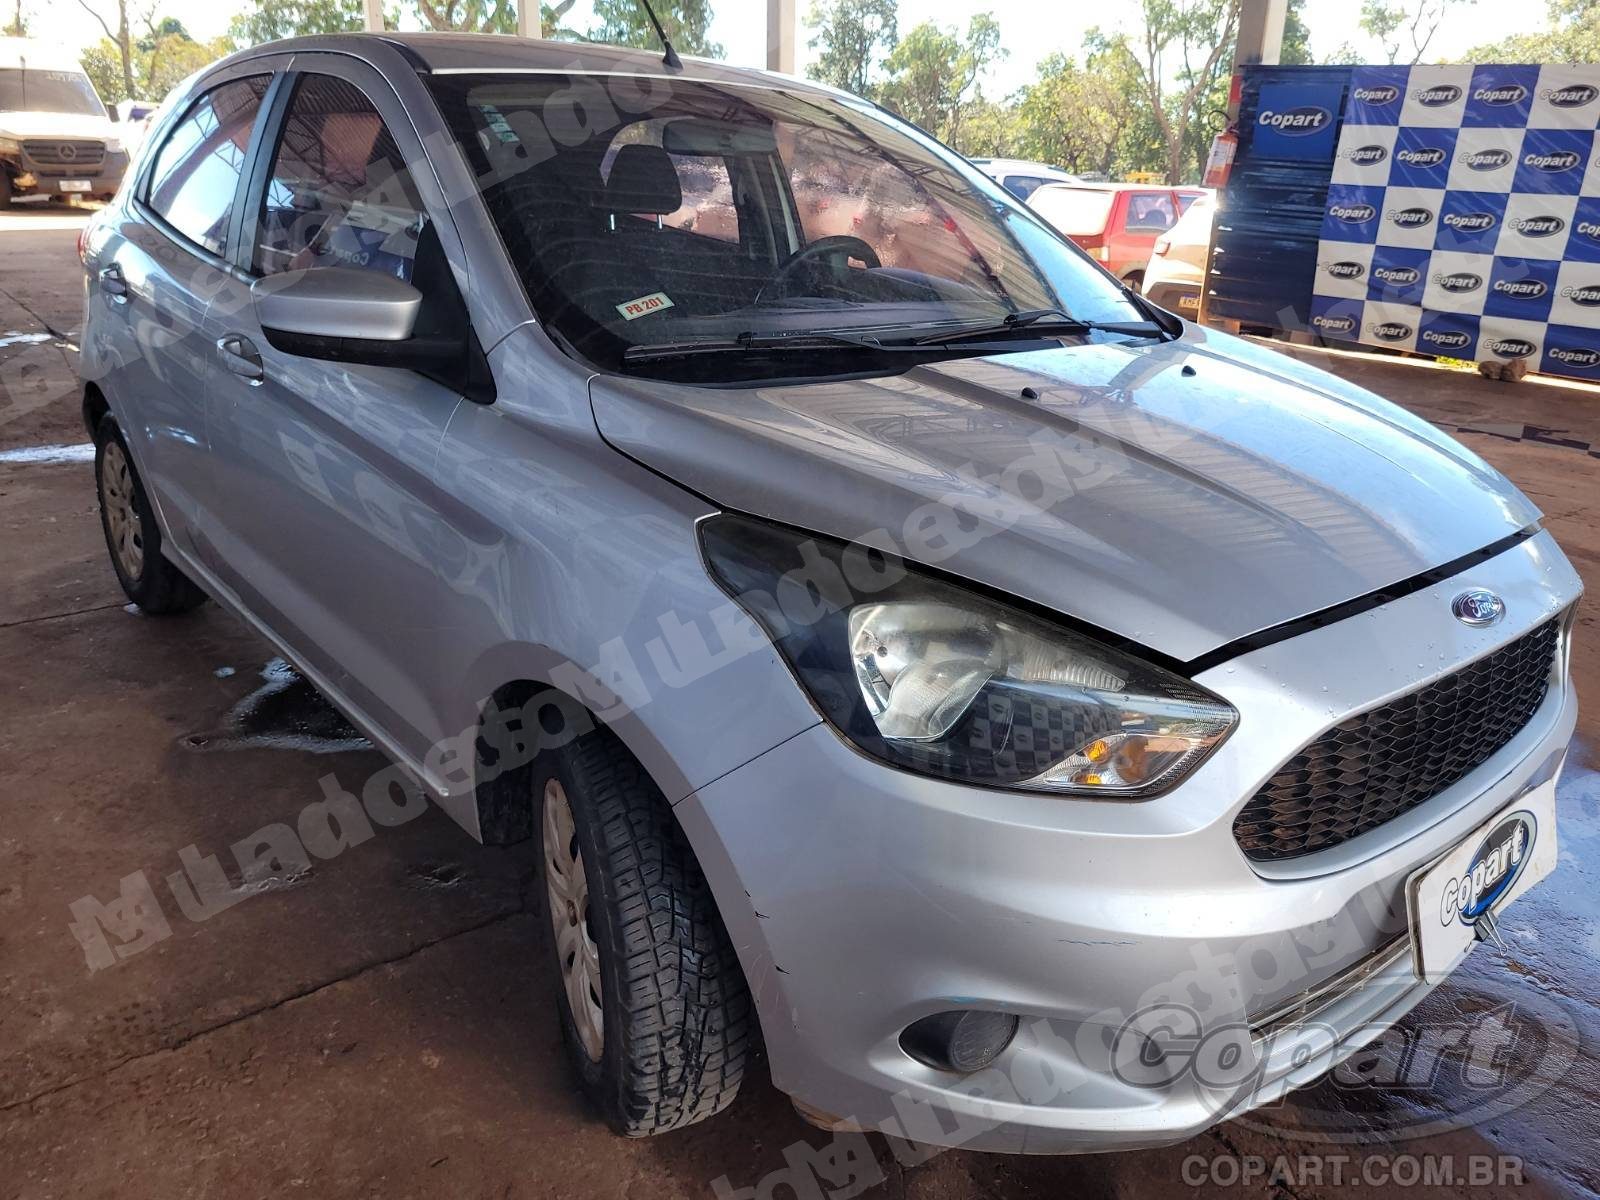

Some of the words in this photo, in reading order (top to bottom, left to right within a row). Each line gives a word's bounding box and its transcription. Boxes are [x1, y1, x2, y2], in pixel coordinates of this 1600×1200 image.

[1353, 88, 1394, 101] Copart
[1410, 89, 1455, 101] Copart
[1473, 89, 1521, 100] Copart
[1540, 89, 1591, 101] Copart
[1258, 111, 1323, 129] Copart
[1343, 148, 1382, 161] Copart
[1396, 150, 1440, 162] Copart
[1457, 152, 1504, 165] Copart
[1524, 154, 1574, 167] Copart
[1329, 205, 1371, 218] Copart
[1386, 208, 1427, 223] Copart
[1443, 213, 1489, 228] Copart
[1508, 218, 1556, 232] Copart
[1321, 261, 1358, 275] Copart
[1374, 268, 1415, 281] Copart
[1432, 273, 1476, 288] Copart
[1493, 279, 1541, 294] Copart
[625, 303, 644, 315] PB
[641, 296, 664, 310] 201
[1313, 316, 1350, 330] Copart
[1366, 322, 1406, 337] Copart
[1422, 330, 1466, 345] Copart
[1483, 338, 1530, 354] Copart
[1548, 348, 1598, 363] Copart
[1440, 819, 1524, 928] Copart
